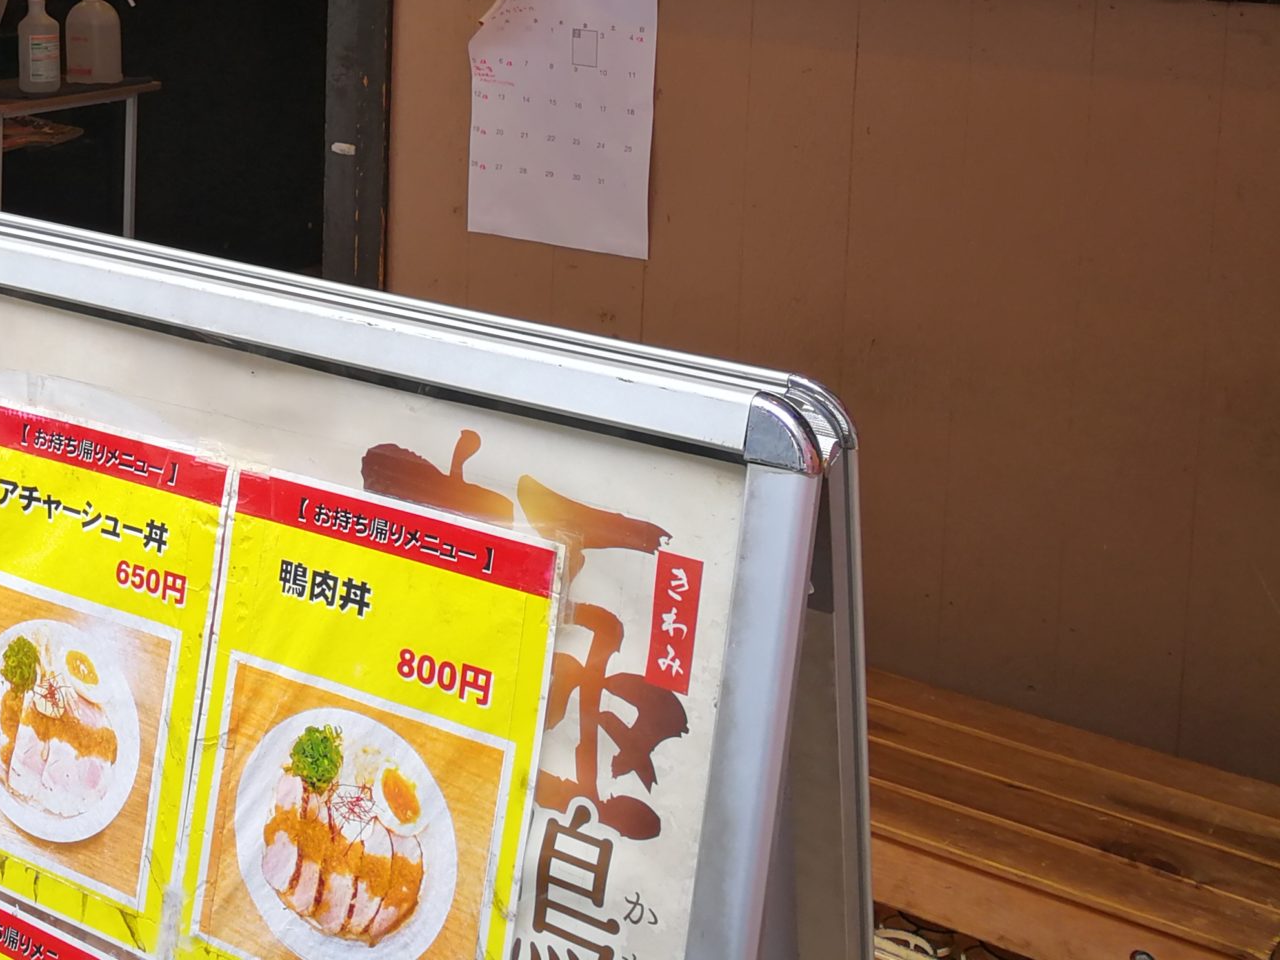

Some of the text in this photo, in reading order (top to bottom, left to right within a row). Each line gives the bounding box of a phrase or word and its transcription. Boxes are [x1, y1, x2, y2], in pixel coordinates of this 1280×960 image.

[20, 424, 178, 484] 【お持ち帰りメニュー】
[297, 496, 496, 574] 【お持ち帰りメニュー】
[115, 560, 188, 606] 650円
[278, 559, 373, 617] 鴨肉丼
[657, 566, 691, 680] きわみ
[396, 648, 494, 708] 800円
